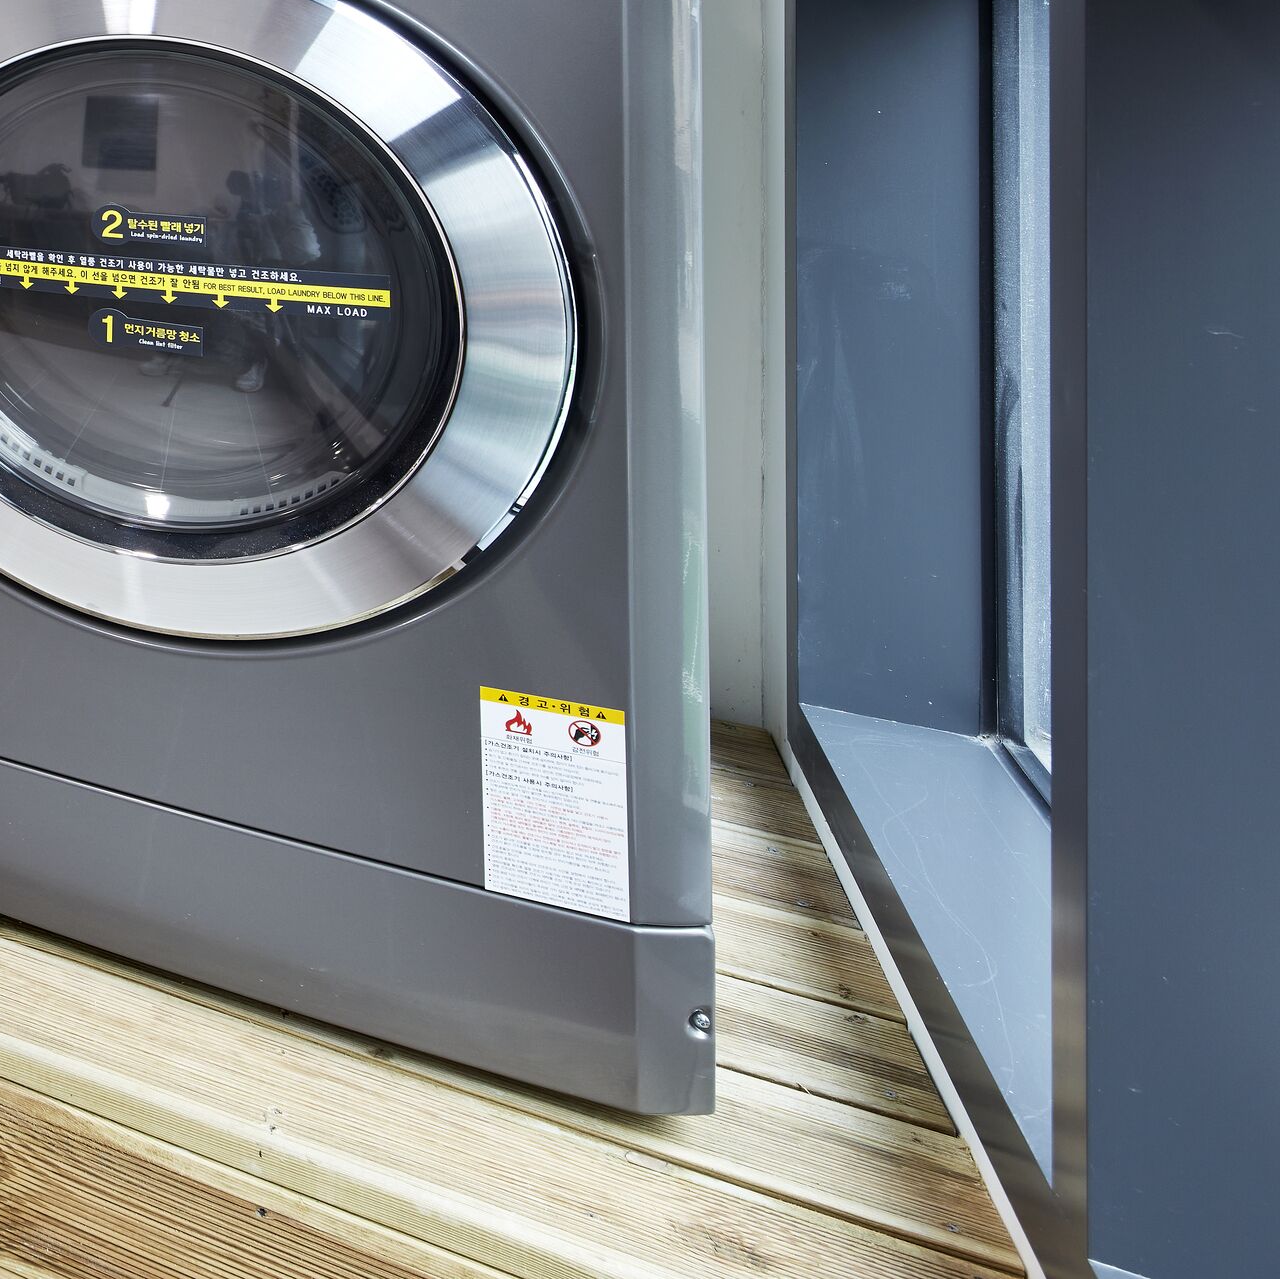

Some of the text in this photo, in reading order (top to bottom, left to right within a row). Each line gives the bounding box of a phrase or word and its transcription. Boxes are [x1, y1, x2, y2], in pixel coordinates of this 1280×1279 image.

[101, 209, 204, 239] 2 탈수된 빨래 넣기
[147, 233, 178, 241] spin-dried
[179, 235, 203, 244] laundry
[6, 249, 302, 283] 세탁라벨을 확인 후 열풍 건조기 사용이 가능한 세탁물만 넣고 건조하세요.
[5, 262, 20, 273] 넘지
[23, 264, 38, 274] 않게
[81, 270, 88, 280] 이
[92, 271, 108, 282] 선을
[112, 273, 136, 284] 넘으면
[140, 275, 166, 287] 건조가
[170, 278, 178, 288] 잘
[183, 279, 200, 290] 안됨
[219, 284, 235, 292] BEST
[267, 287, 285, 296] LOAD
[288, 289, 320, 298] LAUNDRY
[323, 292, 347, 301] BELOW
[350, 293, 366, 301] THIS
[307, 304, 368, 318] MAX LOAD
[101, 315, 114, 343] 1
[179, 330, 201, 343] 청소
